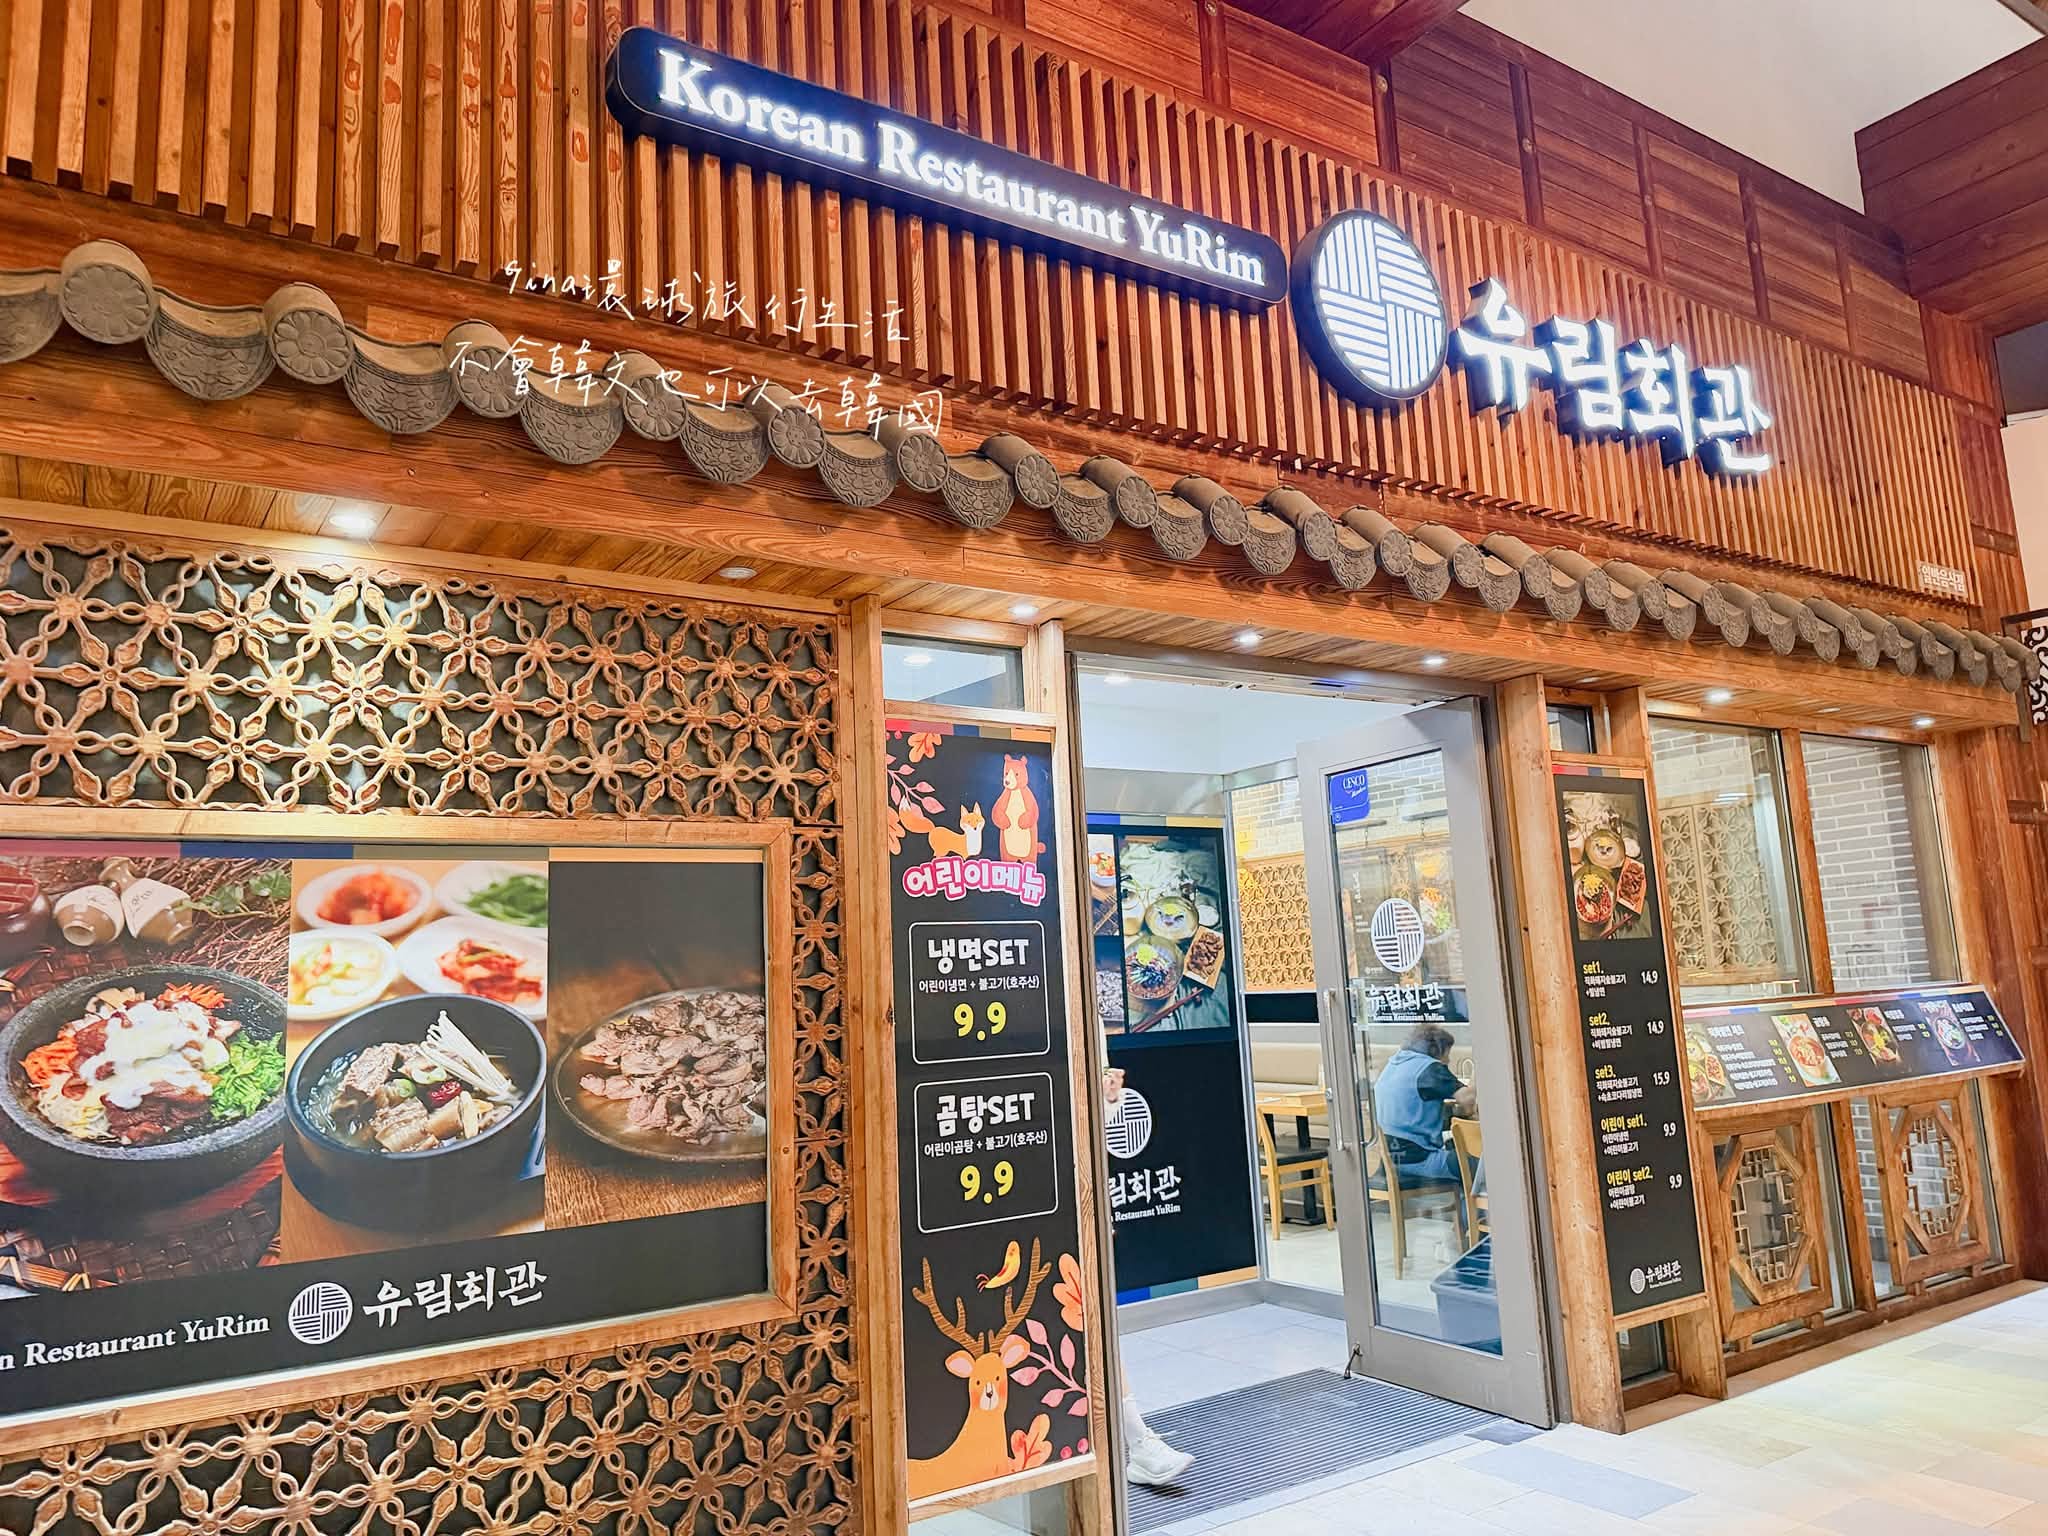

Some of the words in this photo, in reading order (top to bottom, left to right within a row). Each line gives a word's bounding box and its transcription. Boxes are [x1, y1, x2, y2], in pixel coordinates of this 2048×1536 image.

[658, 48, 865, 162] Korean
[876, 122, 1127, 244] Restaurant
[1130, 206, 1265, 286] YuRim
[1457, 277, 1772, 472] 유림회관
[1921, 565, 1965, 592] 일반음식점
[904, 857, 1045, 905] 어린이메뉴
[928, 938, 1029, 974] 냉면SET
[919, 978, 967, 993] 어린이냉면
[979, 975, 1040, 991] 불고기(호주산)
[953, 1001, 1007, 1041] 9.9
[937, 1092, 1035, 1137] 곰탕SET
[1601, 1116, 1625, 1132] 어린이
[1663, 1122, 1676, 1137] 9.9
[924, 1139, 973, 1157] 어린이곰탕
[985, 1130, 1048, 1151] 불고기(호주산)
[960, 1160, 1014, 1204] 9.9
[1607, 1169, 1631, 1186] 어린이
[1669, 1174, 1682, 1189] 9.9
[1115, 1208, 1155, 1221] Restaurant
[1155, 1203, 1181, 1215] YuRim
[1646, 1260, 1681, 1283] 유림회관
[362, 1261, 547, 1328] 유림회관
[24, 1326, 175, 1367] Restaurant
[181, 1314, 270, 1344] YuRim
